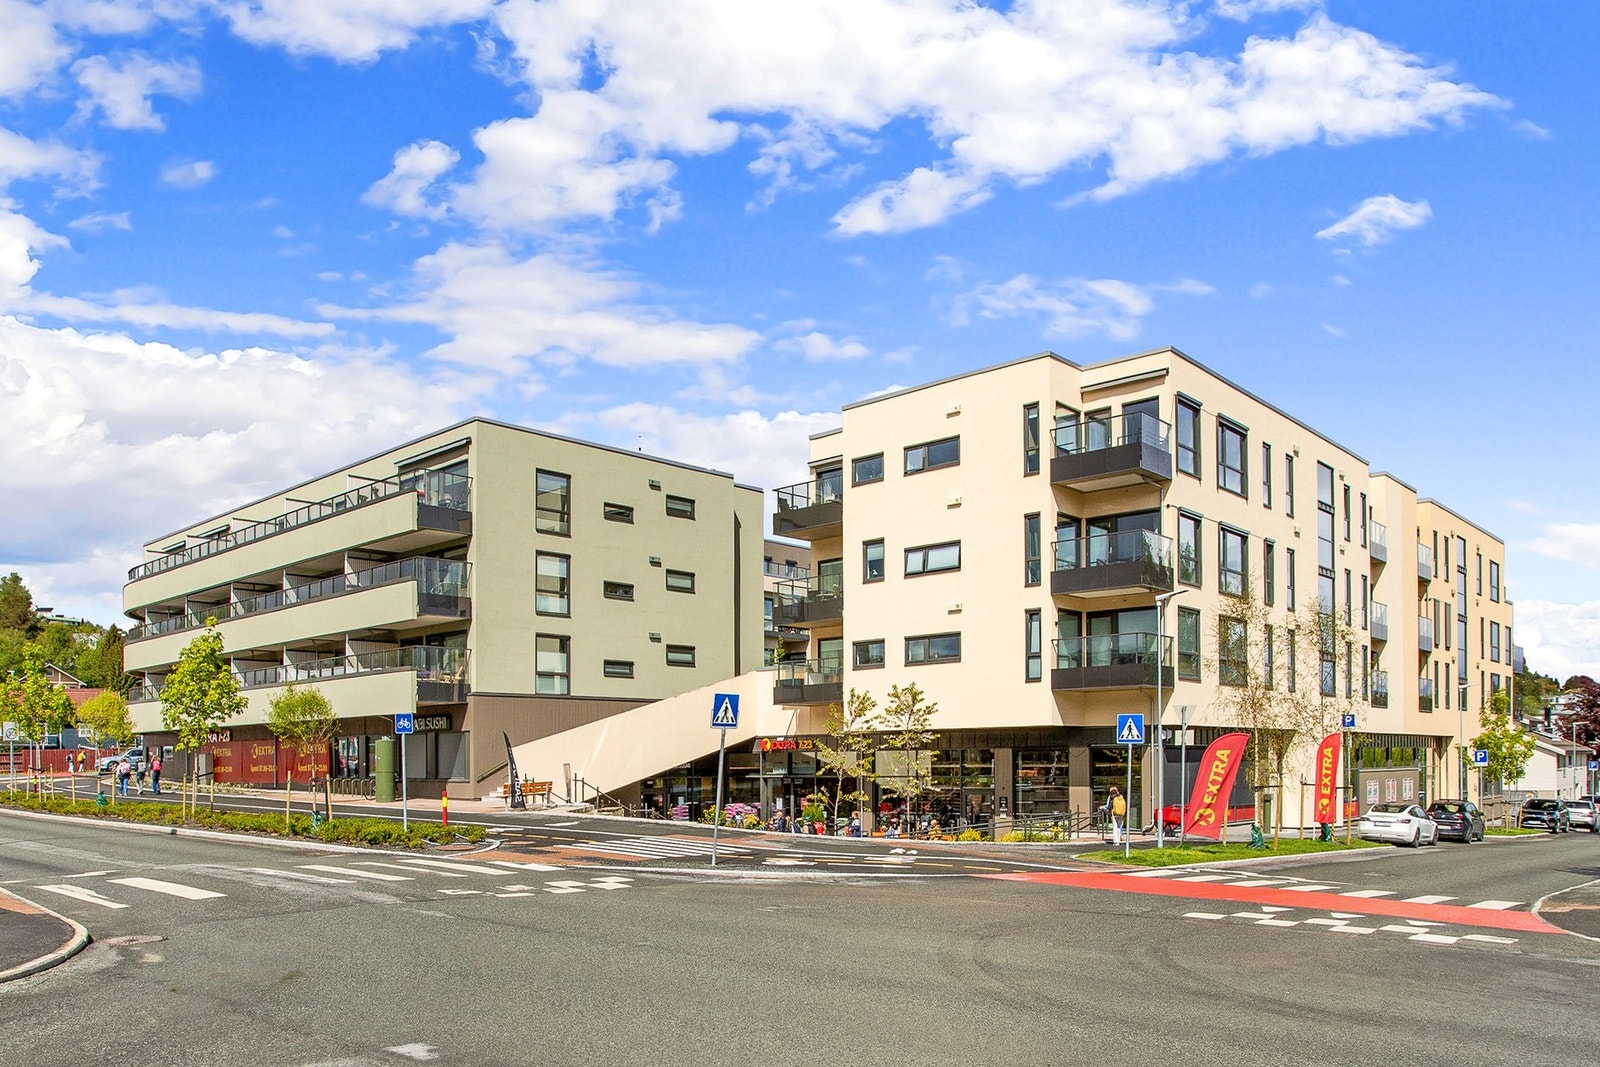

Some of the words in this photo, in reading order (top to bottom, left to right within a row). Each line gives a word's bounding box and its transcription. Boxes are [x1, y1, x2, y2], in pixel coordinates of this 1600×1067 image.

[413, 718, 426, 730] ABI
[426, 716, 447, 730] SUSHI
[1344, 715, 1352, 726] P
[771, 740, 797, 749] EXTRA
[216, 747, 232, 757] EXTRA
[1477, 752, 1485, 761] P
[1321, 746, 1333, 796] EXTRA
[1203, 749, 1232, 805] EXTRA
